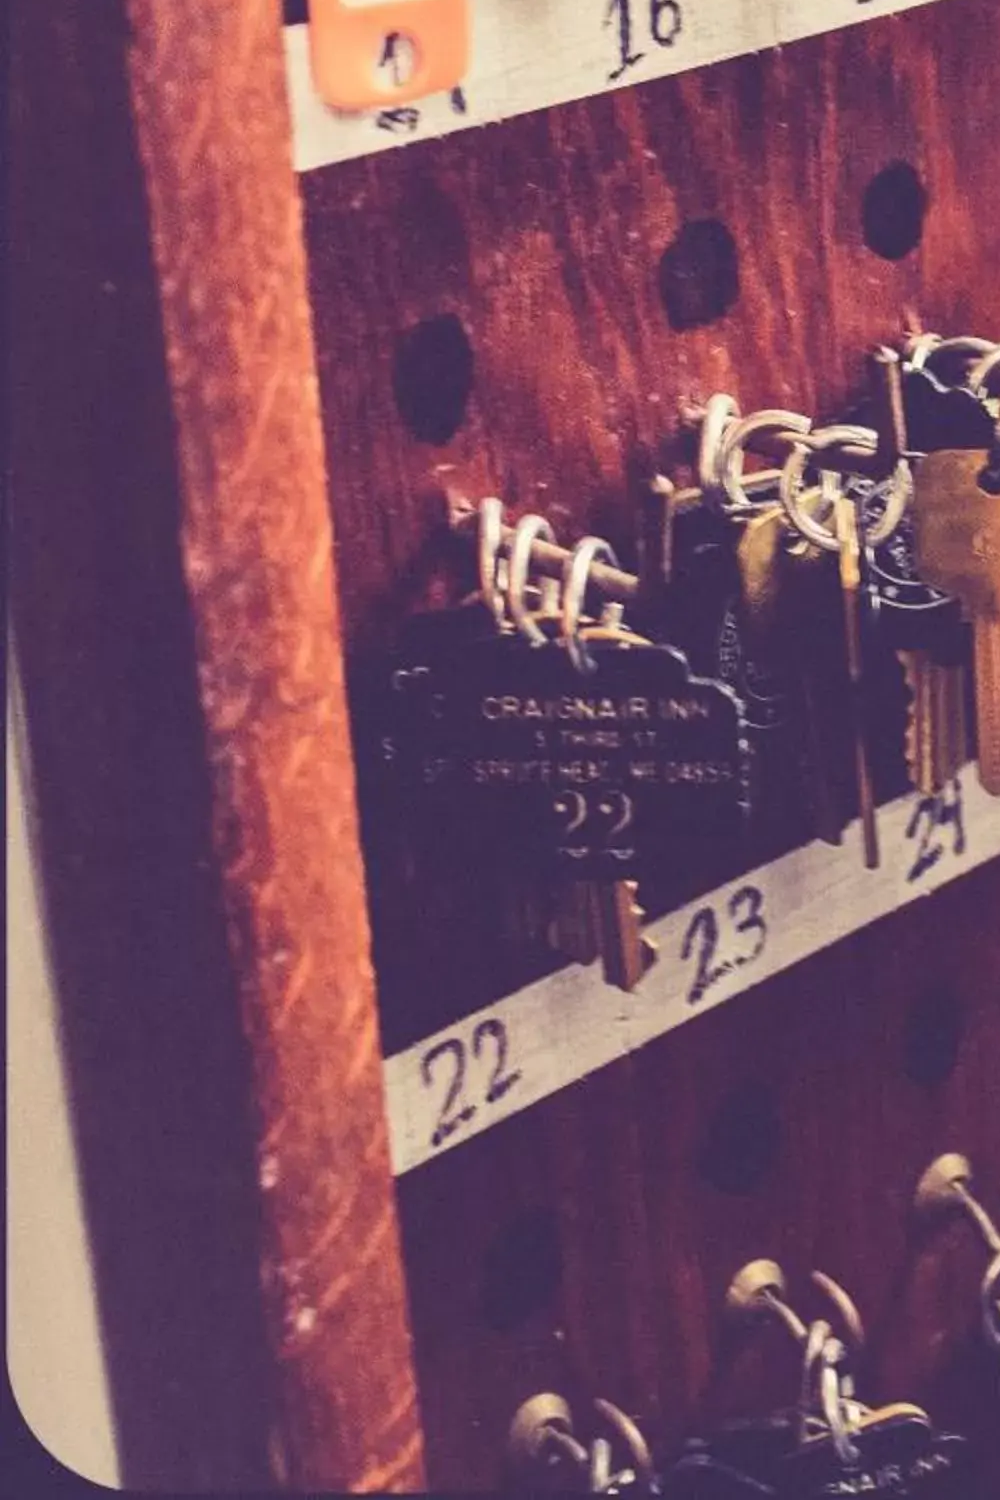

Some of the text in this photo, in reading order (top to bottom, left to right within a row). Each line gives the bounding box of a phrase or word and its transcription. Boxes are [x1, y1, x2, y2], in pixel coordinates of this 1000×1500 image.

[481, 695, 709, 720] CRAIGNAIR INN
[554, 789, 636, 860] 22
[421, 1018, 522, 1146] 22
[680, 886, 767, 1005] 23
[905, 778, 966, 884] 24
